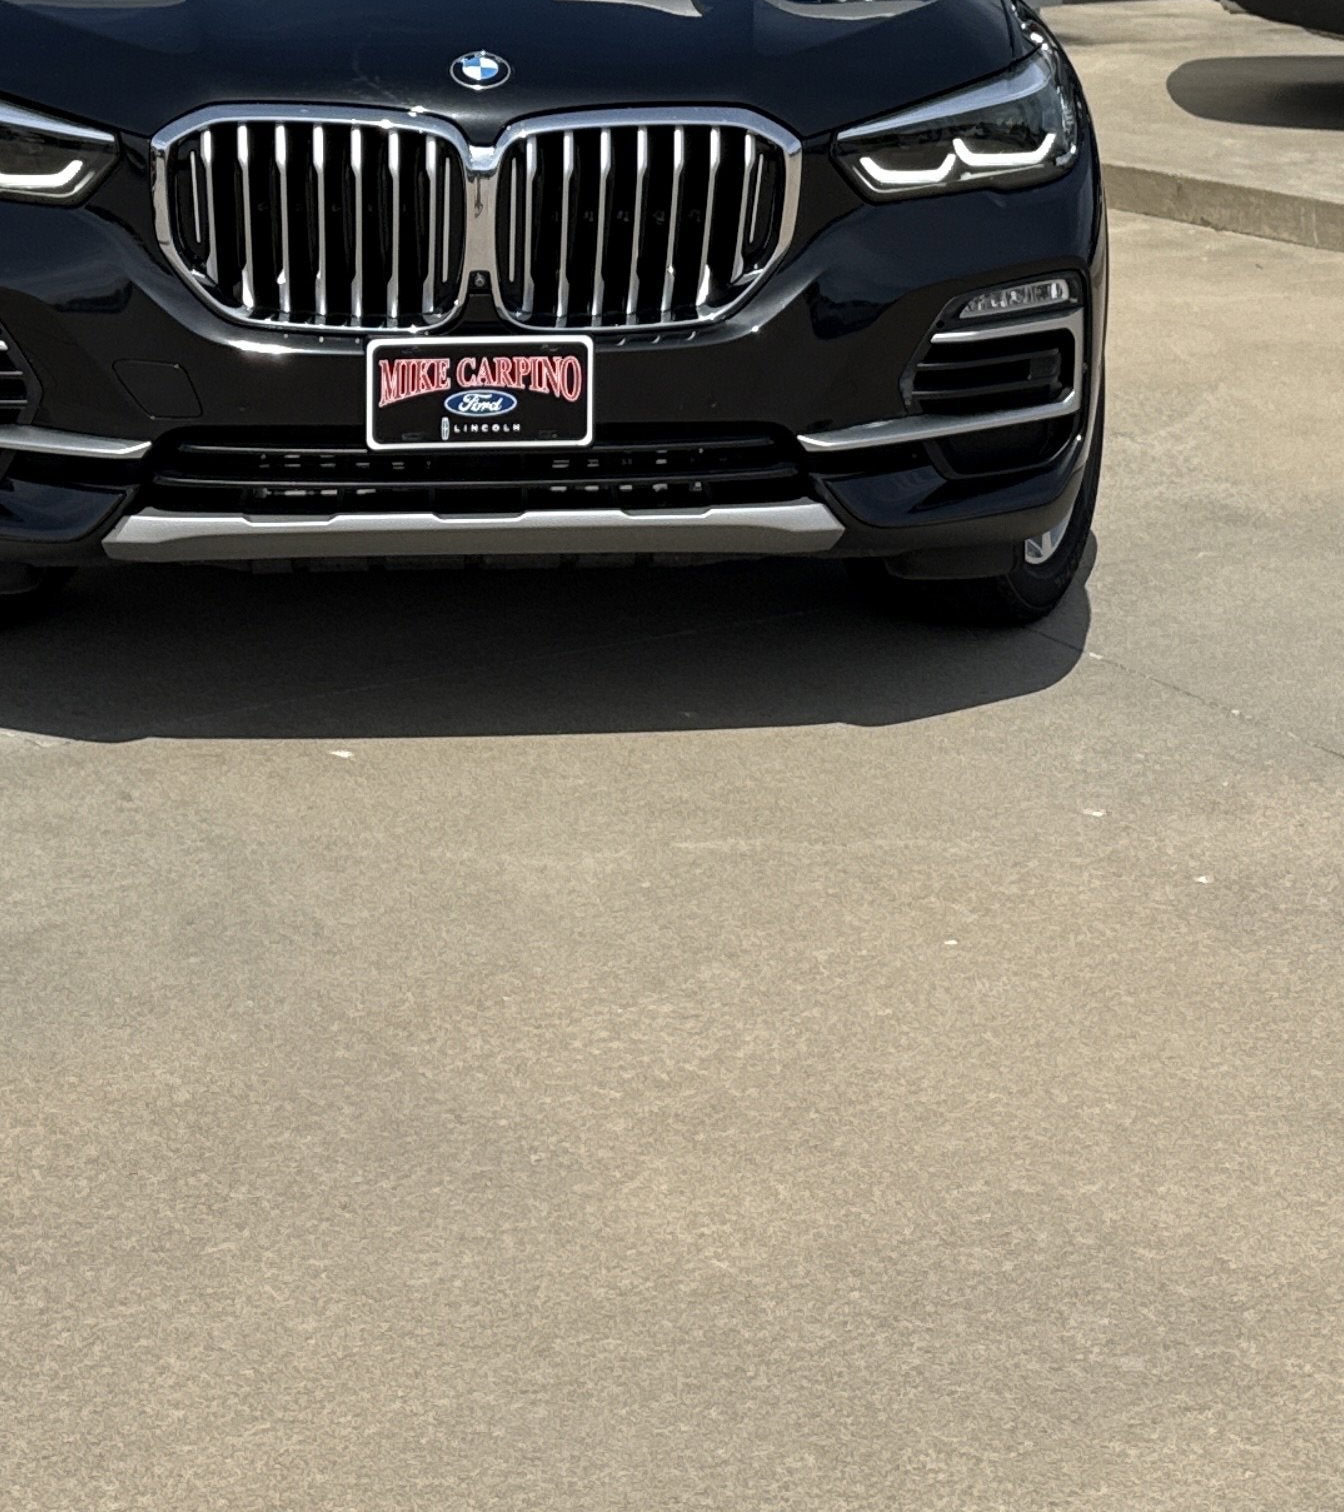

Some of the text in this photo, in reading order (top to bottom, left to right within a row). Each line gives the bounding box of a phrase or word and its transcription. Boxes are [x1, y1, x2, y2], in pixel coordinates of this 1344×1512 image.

[379, 356, 582, 408] MIKE CARPINO
[458, 393, 503, 412] Ford
[453, 423, 521, 434] LINCOLN
